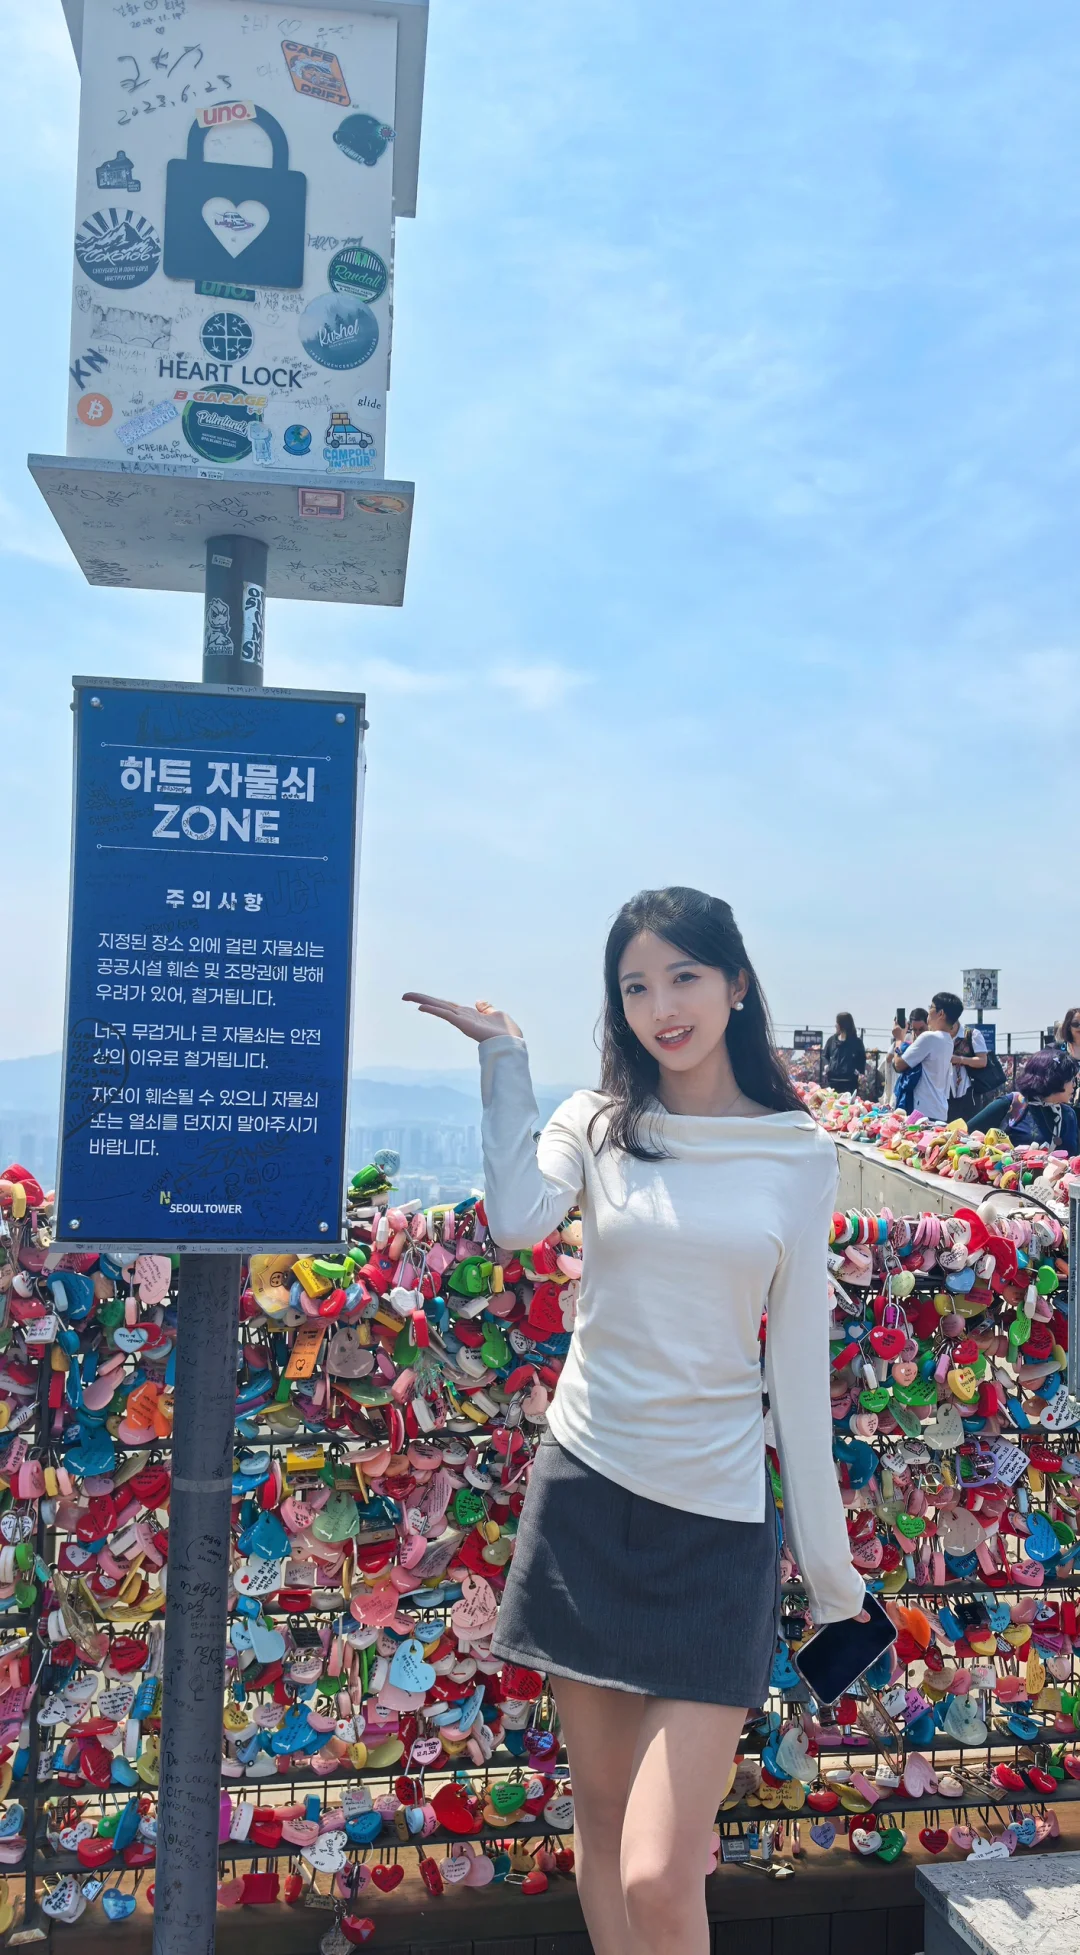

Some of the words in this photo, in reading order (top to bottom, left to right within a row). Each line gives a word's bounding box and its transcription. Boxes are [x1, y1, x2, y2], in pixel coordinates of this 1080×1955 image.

[285, 42, 334, 63] CAFE
[300, 83, 347, 103] DRIFT
[334, 264, 383, 288] Randall
[158, 359, 232, 383] HEART
[242, 366, 303, 389] LOCK
[192, 391, 267, 407] GARAGE
[357, 396, 381, 410] glide
[198, 411, 248, 436] Palmlands
[324, 448, 376, 461] CAMPOLO
[119, 755, 193, 795] 하트
[206, 762, 315, 803] 자물쇠
[152, 803, 280, 844] ZONE
[98, 932, 147, 951] 지정된
[152, 935, 184, 952] 장소
[188, 936, 221, 954] 외에
[225, 938, 257, 955] 걸린
[261, 940, 325, 958] 자물쇠는
[97, 958, 162, 977] 공공시설
[167, 961, 199, 978] 훼손
[204, 962, 219, 979] 및
[224, 963, 288, 982] 조망권에
[293, 966, 324, 983] 방해
[95, 984, 146, 1002] 우려가
[150, 986, 186, 1005] 있어,
[191, 987, 276, 1006] 철거됩니다.
[94, 1022, 127, 1040] 너무
[131, 1023, 197, 1042] 무겁거나
[201, 1025, 217, 1042] 큰
[222, 1026, 285, 1044] 자물쇠는
[290, 1028, 321, 1045] 안전
[93, 1048, 125, 1065] 상의
[130, 1049, 179, 1067] 이유로
[184, 1050, 269, 1069] 철거됩니다.
[92, 1086, 140, 1104] 자연이
[145, 1087, 194, 1105] 훼손될
[198, 1089, 215, 1106] 수
[219, 1089, 267, 1107] 있으니
[271, 1091, 319, 1108] 자물쇠
[90, 1112, 123, 1130] 또는
[129, 1113, 178, 1131] 열쇠를
[184, 1114, 232, 1132] 던지지
[237, 1115, 318, 1134] 말아주시기
[89, 1138, 159, 1156] 바랍니다.
[159, 1191, 171, 1206] N
[169, 1203, 242, 1214] SEOULTOWER
